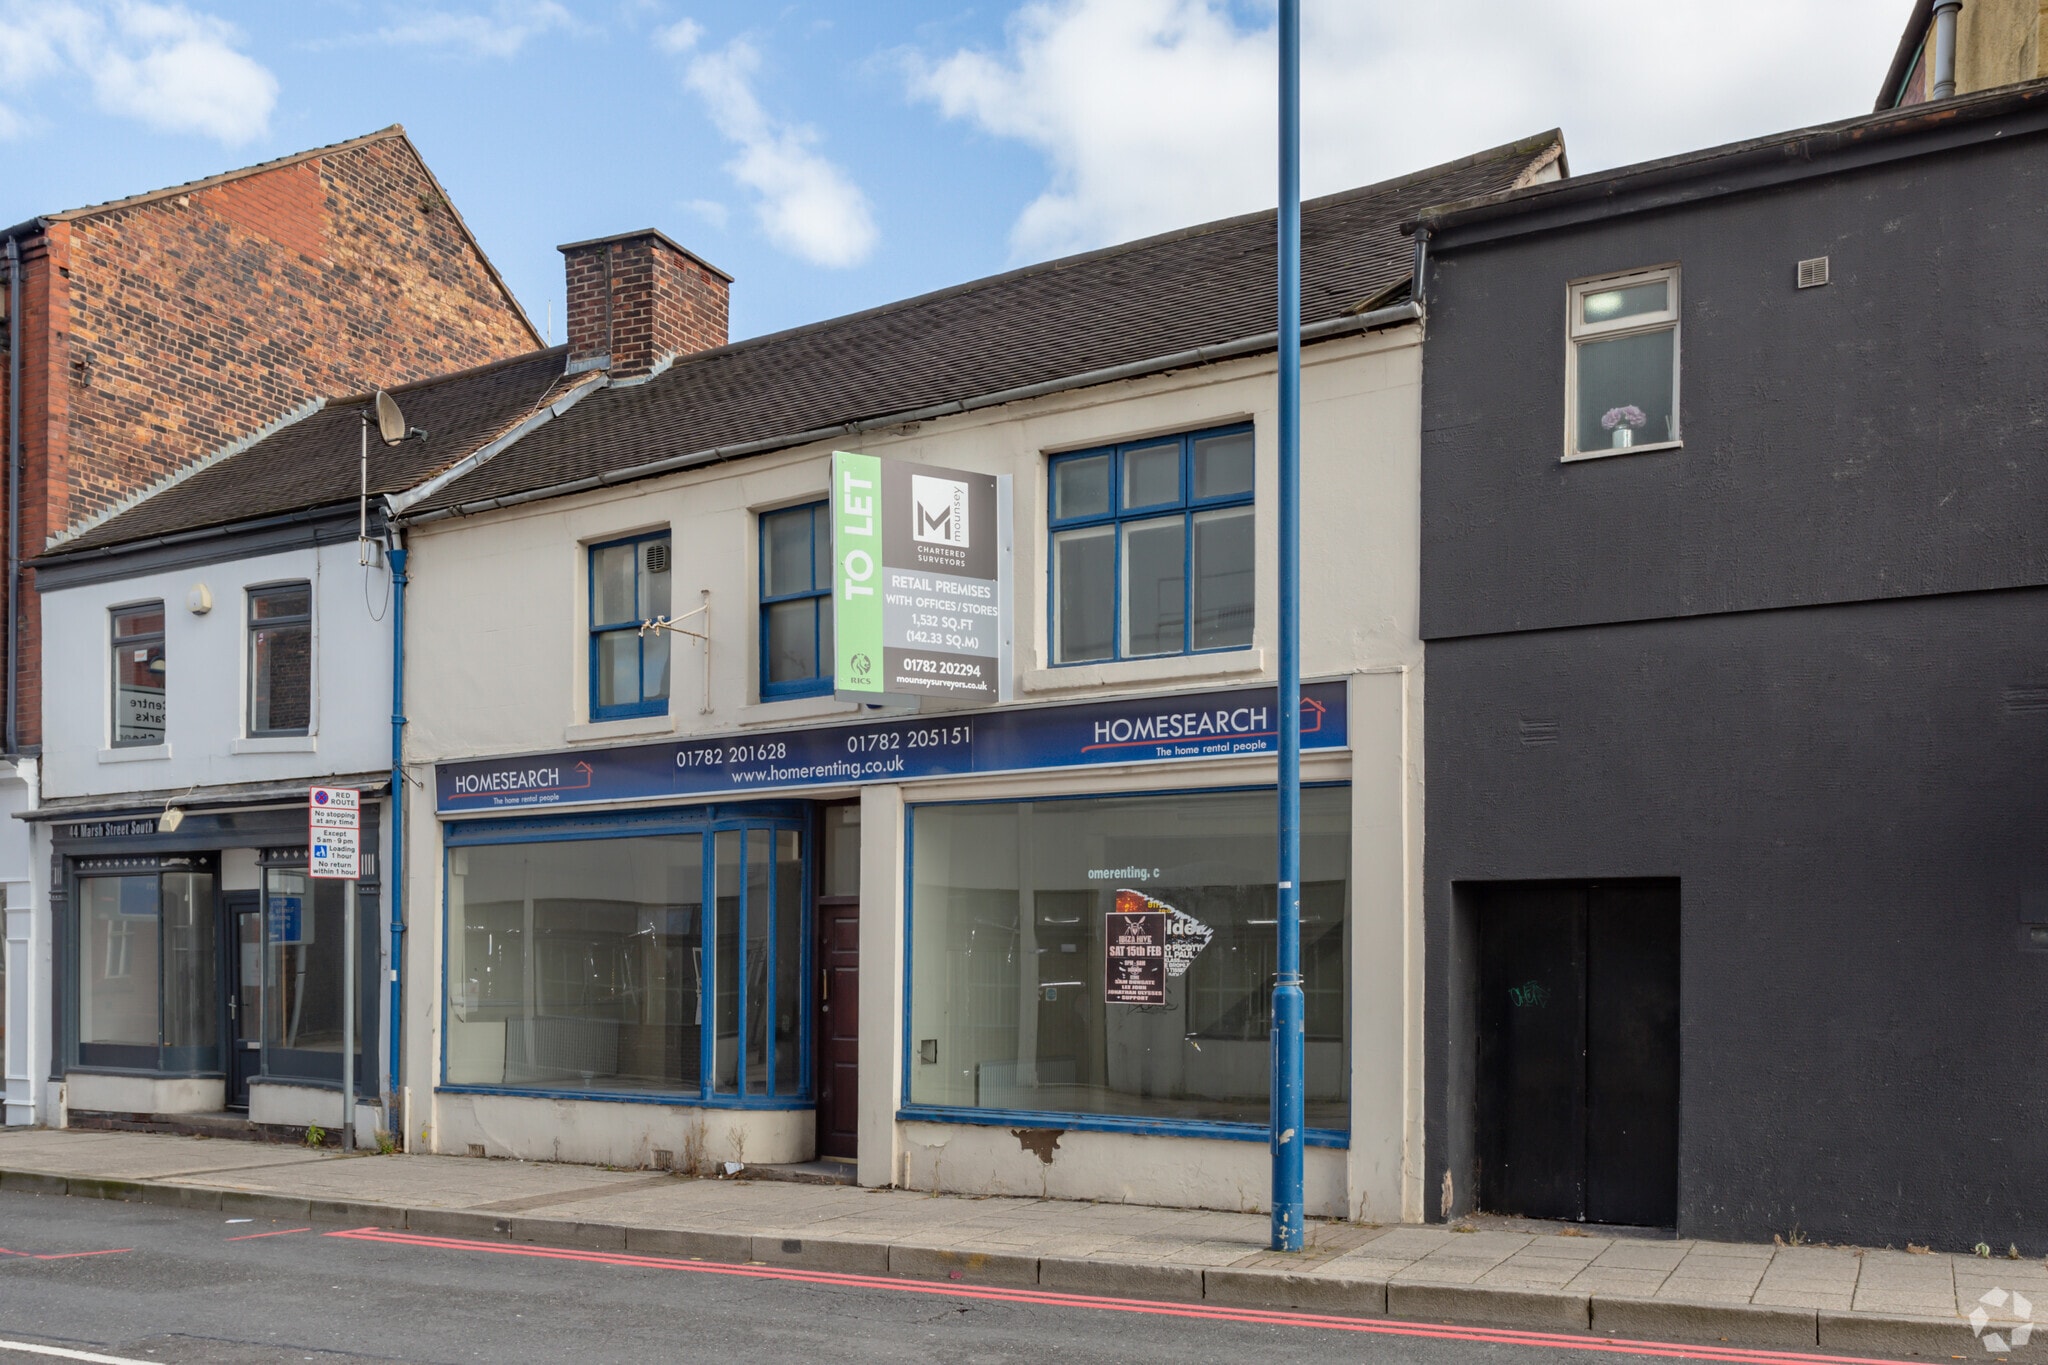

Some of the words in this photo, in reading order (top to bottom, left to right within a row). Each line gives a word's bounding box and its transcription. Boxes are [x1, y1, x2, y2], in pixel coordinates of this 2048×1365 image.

[844, 471, 873, 536] LET
[953, 486, 964, 542] mounsey
[917, 546, 966, 558] CHARTERED
[917, 555, 966, 567] SURVEYORS
[845, 550, 874, 600] TO
[891, 575, 931, 592] RETAIL
[935, 580, 991, 598] PREMISES
[886, 594, 912, 606] WITH
[911, 613, 938, 628] 1,532
[941, 617, 973, 630] SQ.FT
[906, 629, 942, 644] (142.33
[946, 634, 979, 649] SQ.M)
[903, 658, 937, 673] 01782
[940, 661, 981, 677] 202294
[850, 677, 871, 685] RICS
[896, 676, 988, 691] mounseysurveyors.co.uk
[1094, 707, 1267, 743] HOMESEARCH
[847, 732, 900, 753] 01782
[908, 726, 970, 748] 205151
[676, 748, 723, 768] 01782
[729, 742, 787, 763] 201628
[1156, 747, 1172, 757] The
[1175, 745, 1199, 755] home
[1203, 742, 1230, 753] rental
[1233, 740, 1267, 752] people
[732, 755, 904, 783] www.homerenting.co.uk
[455, 767, 559, 793] HOMESEARCH
[493, 797, 504, 805] The
[504, 796, 519, 804] home
[521, 794, 538, 803] rental
[539, 793, 560, 803] people
[326, 811, 355, 819] stopping
[69, 825, 79, 837] 44
[80, 823, 103, 837] Marsh
[105, 822, 129, 836] Street
[131, 820, 154, 835] South
[329, 845, 355, 853] Loading
[1109, 946, 1125, 957] SAT
[1126, 946, 1145, 957] 15th
[1146, 946, 1162, 957] FEB
